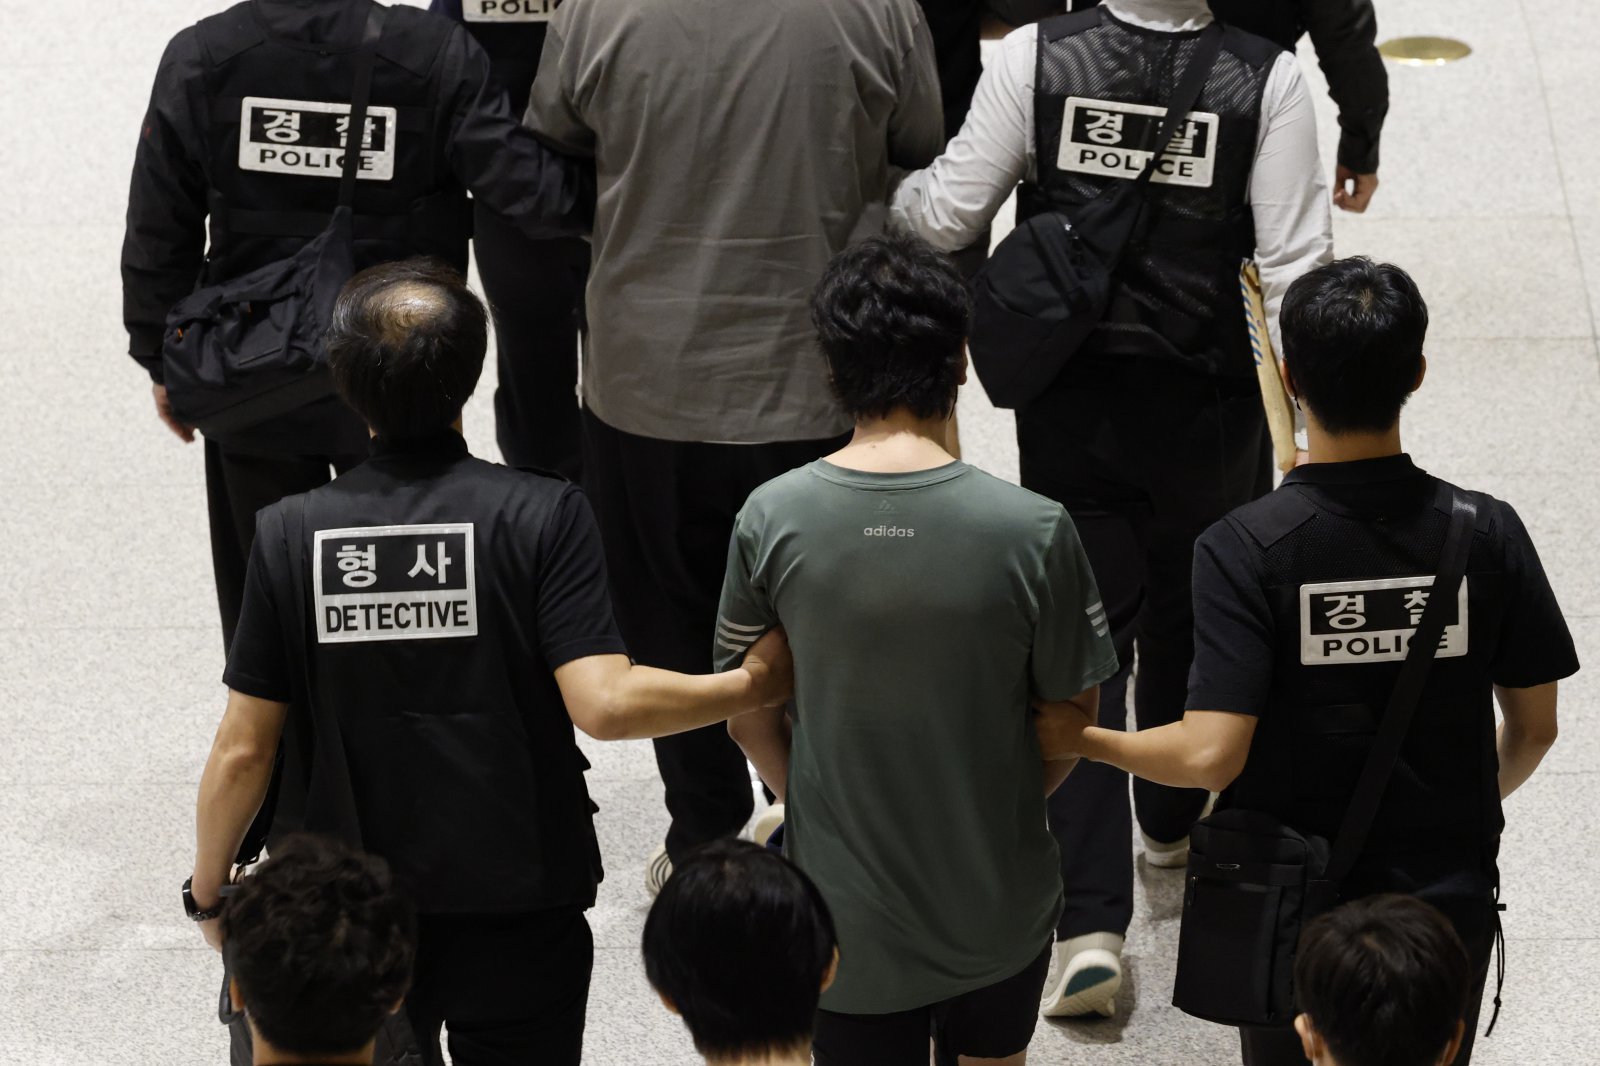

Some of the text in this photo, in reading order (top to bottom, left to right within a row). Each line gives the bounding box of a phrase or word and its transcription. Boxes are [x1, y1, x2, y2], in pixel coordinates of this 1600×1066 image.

[481, 0, 563, 14] POLI
[863, 525, 915, 537] adidas
[325, 600, 469, 633] DETECTIVE
[1323, 631, 1448, 656] POLI
